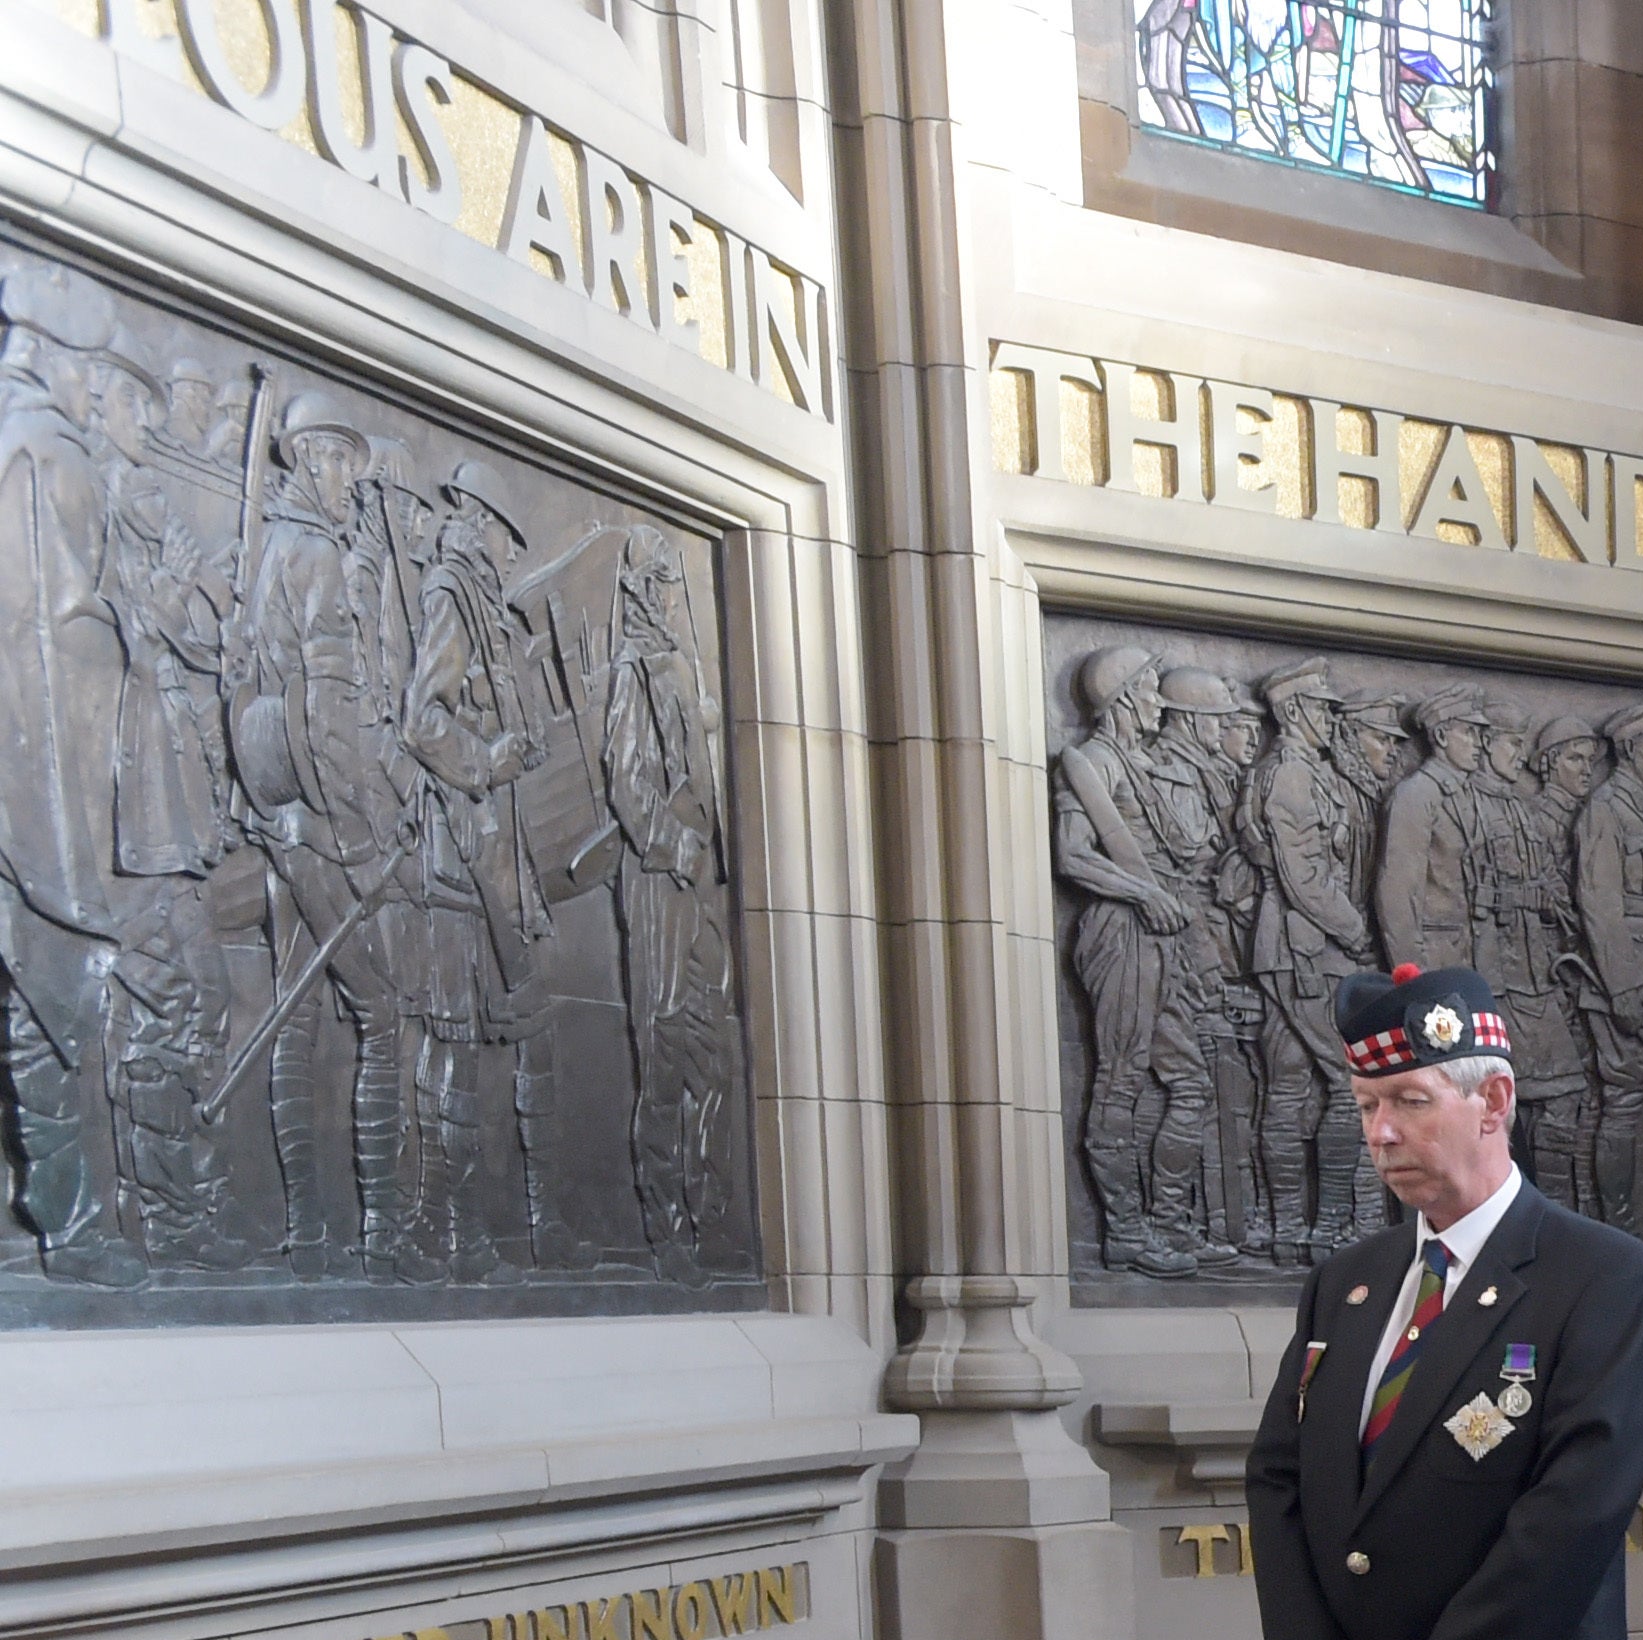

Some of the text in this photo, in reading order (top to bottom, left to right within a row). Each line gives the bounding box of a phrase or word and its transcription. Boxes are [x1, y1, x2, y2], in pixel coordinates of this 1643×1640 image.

[503, 114, 700, 350] ARE
[724, 231, 832, 422] IN
[993, 341, 1277, 512] THE
